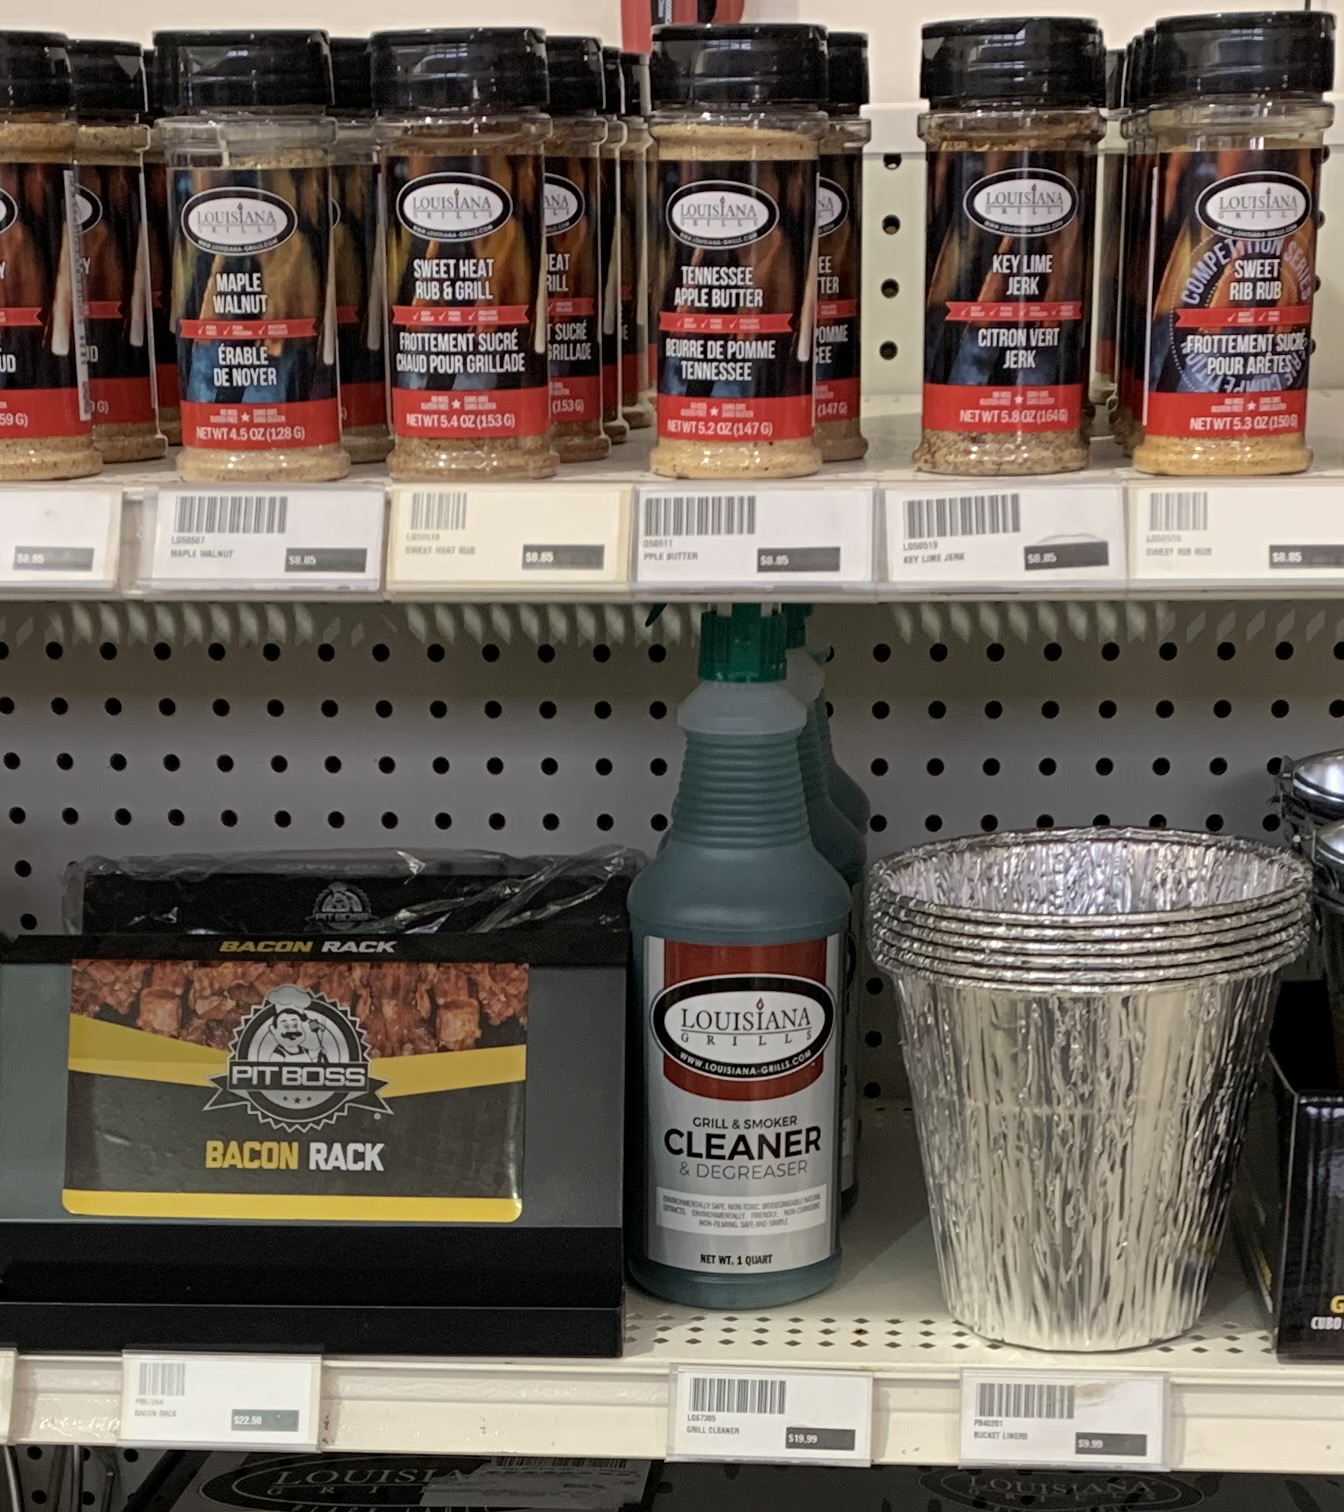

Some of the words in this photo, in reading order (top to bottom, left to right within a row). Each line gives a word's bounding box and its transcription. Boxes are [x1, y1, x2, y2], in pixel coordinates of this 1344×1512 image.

[197, 204, 276, 224] LOUISIANA
[414, 260, 456, 278] SWEET
[459, 259, 494, 277] HEAT
[993, 255, 1020, 273] KEY
[1023, 255, 1053, 273] LIME
[1235, 260, 1280, 278] SWEET
[216, 272, 261, 292] MAPLE
[681, 267, 753, 286] TENNESSEE
[1007, 276, 1039, 295] JERK
[415, 281, 440, 299] RUB
[443, 281, 452, 299] &
[455, 281, 493, 299] GRILL
[675, 290, 709, 307] APPLE
[712, 289, 763, 308] BUTTER
[1230, 282, 1253, 300] RIB
[1256, 281, 1281, 300] RUB
[213, 294, 267, 314] WALNUT
[219, 940, 313, 954] BACON
[321, 940, 397, 954] RACK
[681, 1007, 811, 1032] LOUISIANA
[681, 1030, 812, 1046] GRILLS
[679, 1050, 812, 1077] WWW.LOUISIANA-GRILLS.COM
[232, 1065, 277, 1086] PIT
[282, 1066, 366, 1088] BOSS
[693, 1117, 729, 1129] GRILL
[732, 1119, 740, 1129] &
[744, 1115, 798, 1129] SMOKER
[664, 1126, 821, 1161] CLEANER
[205, 1141, 299, 1170] BACON
[309, 1142, 385, 1172] RACK
[679, 1161, 690, 1177] &
[697, 1160, 807, 1179] DEGREASER
[700, 1255, 716, 1265] NET
[719, 1255, 734, 1265] WT.
[737, 1255, 742, 1265] 1
[745, 1254, 772, 1265] QUART
[709, 1426, 740, 1435] CLEANER
[788, 1434, 818, 1444] $19.99
[1078, 1439, 1103, 1449] $9.99
